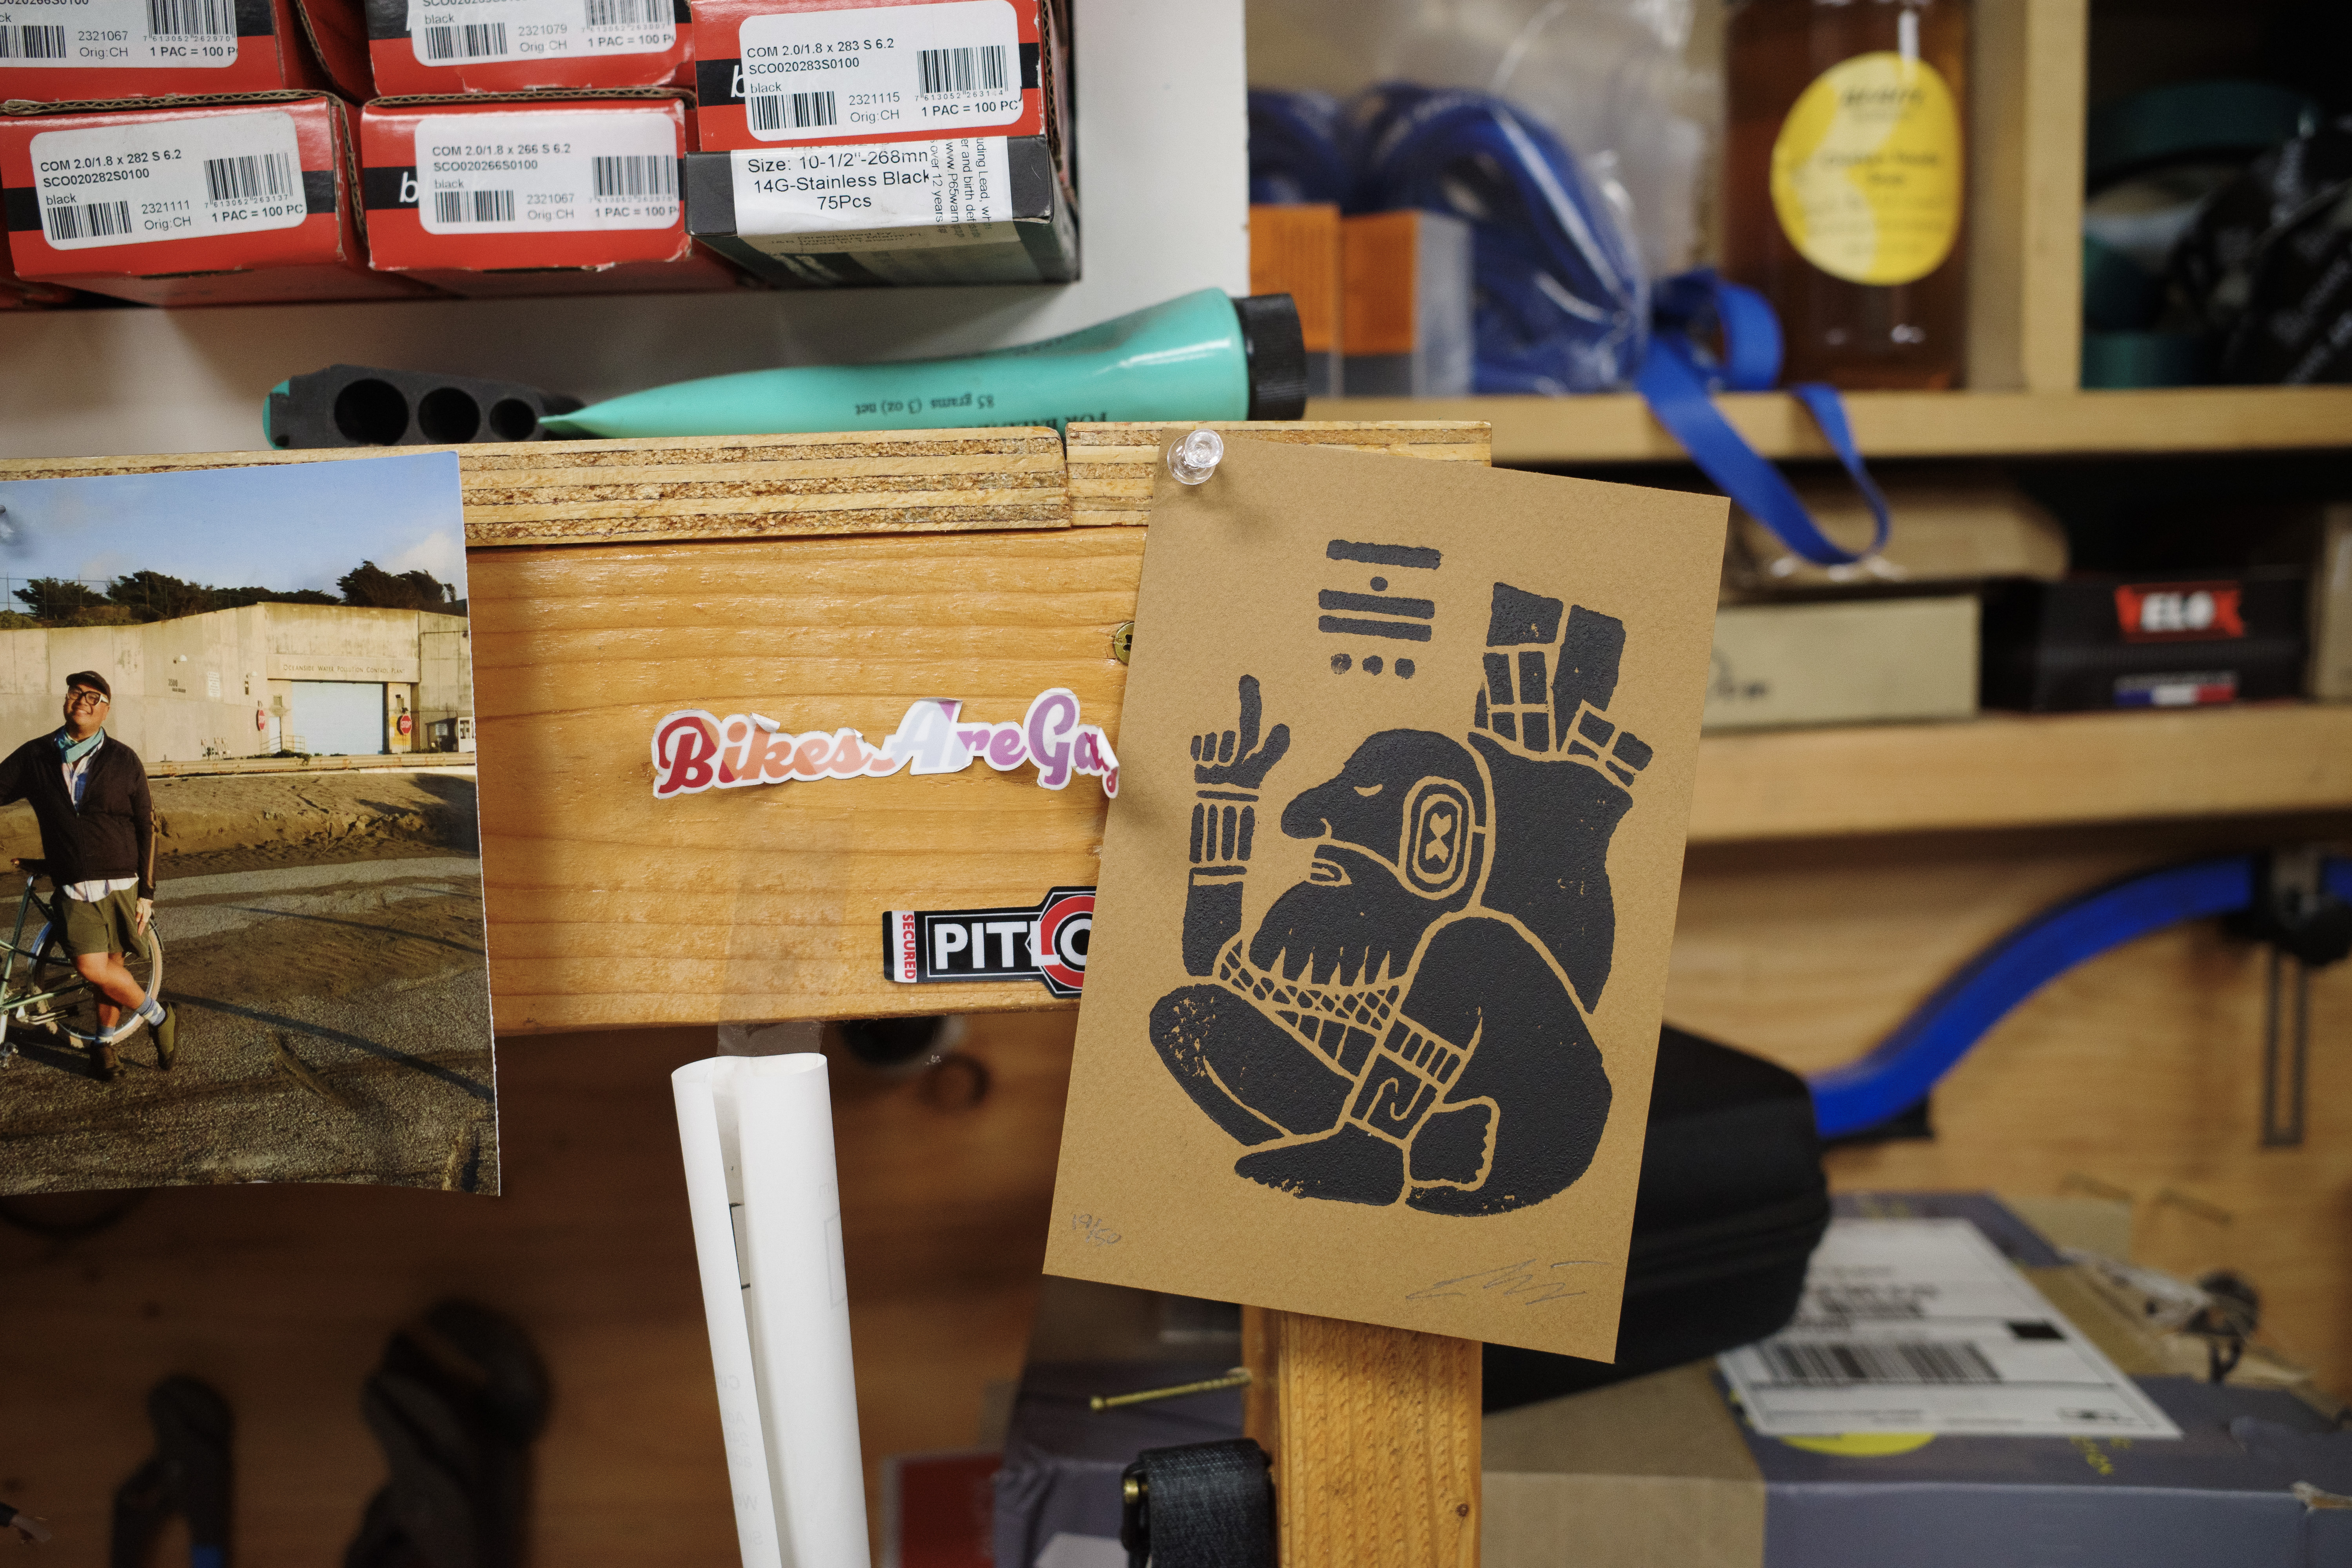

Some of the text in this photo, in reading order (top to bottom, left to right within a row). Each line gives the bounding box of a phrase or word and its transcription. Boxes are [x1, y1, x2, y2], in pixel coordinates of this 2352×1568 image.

[425, 13, 455, 25] black
[78, 31, 128, 41] 2321067
[518, 23, 567, 36] 2321079
[588, 38, 593, 47] 1
[598, 36, 624, 47] PAC
[639, 34, 659, 44] 100
[80, 47, 128, 60] Orig:CH
[151, 47, 155, 56] 1
[161, 47, 187, 56] PAC
[203, 47, 223, 56] 100
[228, 47, 238, 56] P
[747, 38, 894, 58] COM 2.0/1.8 x 283 S 6.2
[749, 57, 859, 74] SCO020283S0100
[751, 82, 782, 93] black
[967, 90, 1003, 98] 26314
[849, 91, 900, 105] 2321115
[922, 107, 926, 116] 1
[933, 105, 959, 116] PAC
[975, 102, 996, 113] 100
[851, 109, 899, 124] Orig:CH
[433, 146, 461, 156] COM
[466, 145, 503, 156] 2.0/1.8
[518, 144, 538, 154] 266
[542, 144, 549, 154] S
[554, 143, 571, 154] 6.2
[41, 160, 70, 172] COM
[74, 156, 113, 169] 2.0/1.8
[127, 152, 149, 164] 282
[152, 151, 160, 161] S
[164, 149, 182, 160] 6.2
[930, 145, 939, 169] over
[962, 152, 973, 172] and
[748, 158, 791, 172] Size:
[43, 168, 149, 187] SCO020282S0100
[435, 179, 464, 189] black
[754, 170, 929, 193] 14G-Stainless Black
[933, 174, 943, 187] 12
[964, 176, 975, 200] birth
[979, 171, 990, 202] Lead,
[46, 193, 77, 205] black
[527, 193, 575, 205] 2321067
[817, 195, 871, 210] 75Pcs
[142, 200, 189, 214] 2321111
[212, 213, 217, 223] 1
[223, 210, 247, 222] PAC
[262, 206, 283, 218] 100
[287, 204, 303, 215] PC
[595, 208, 600, 217] 1
[605, 207, 630, 217] PAC
[646, 206, 665, 216] 100
[669, 206, 679, 215] P
[931, 191, 943, 222] years
[144, 216, 191, 231] Orig:CH
[902, 914, 916, 979] SECURED
